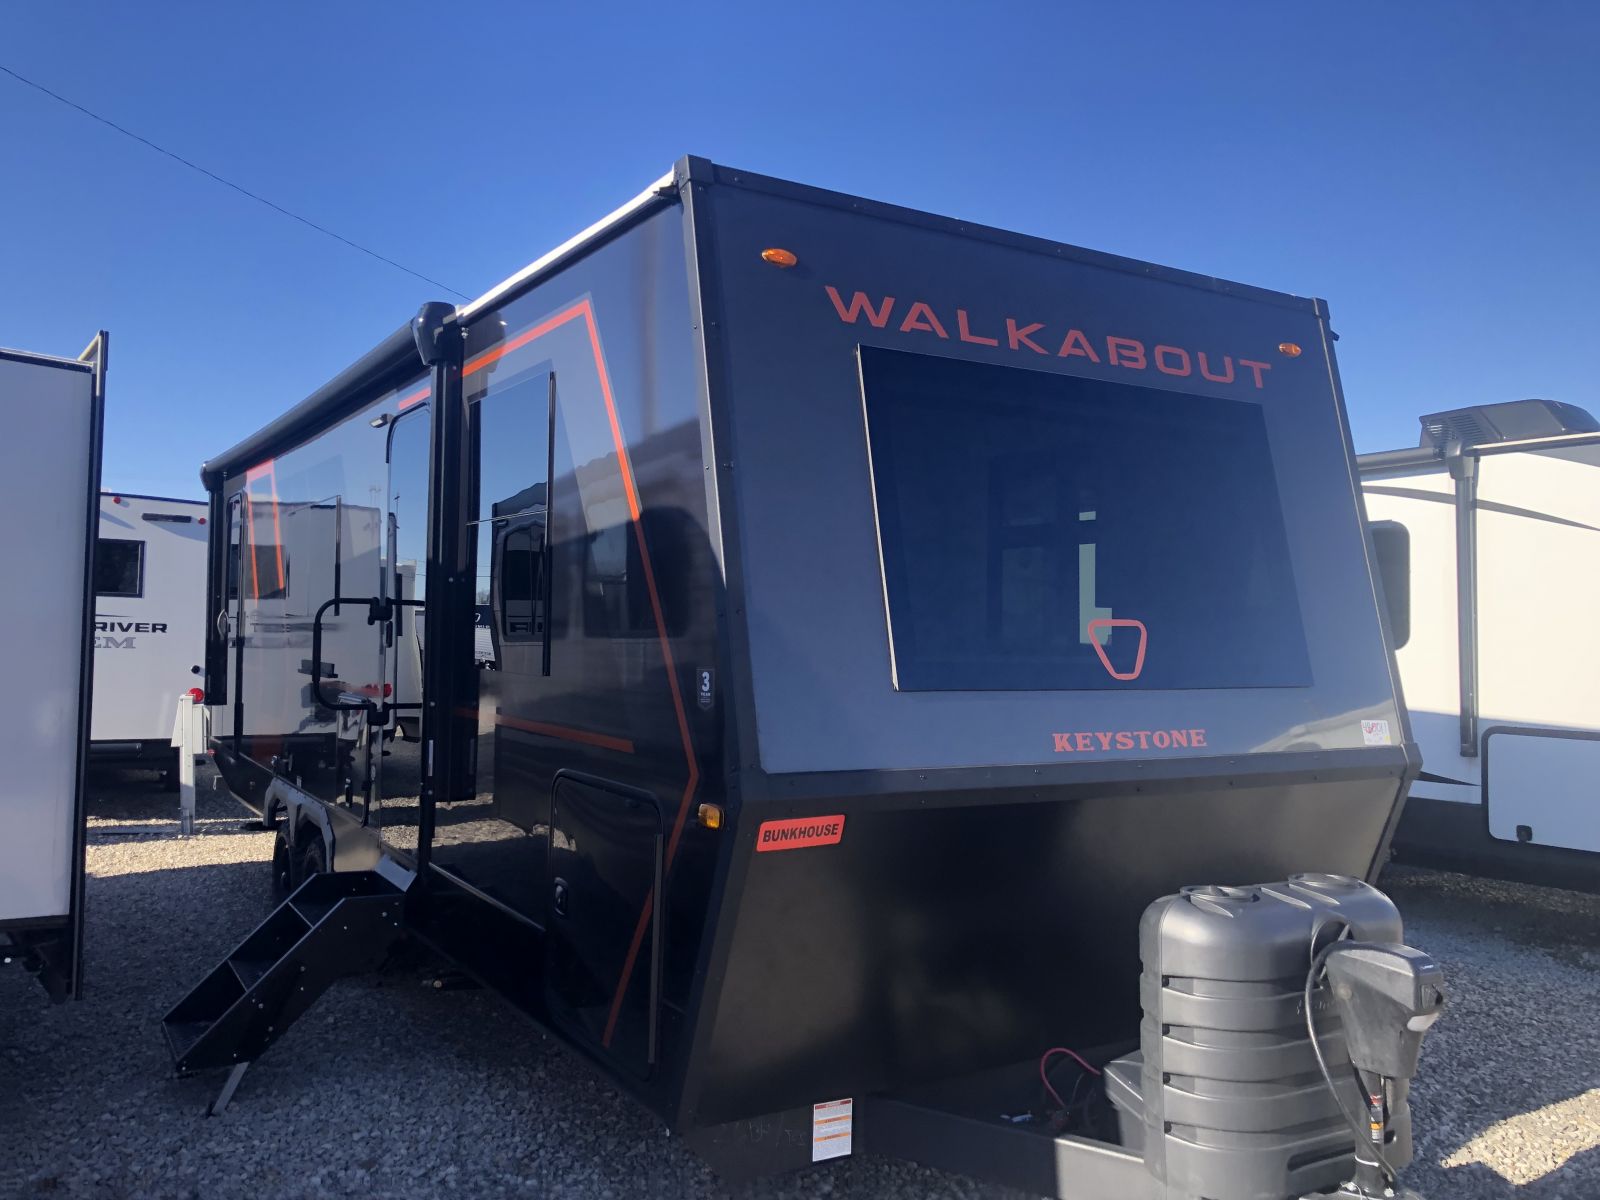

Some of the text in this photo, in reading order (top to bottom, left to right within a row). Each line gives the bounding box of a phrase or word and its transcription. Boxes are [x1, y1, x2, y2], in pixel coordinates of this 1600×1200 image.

[825, 286, 1271, 388] WALKABOUT
[95, 621, 168, 633] RIVER
[702, 671, 710, 692] 3
[1052, 729, 1208, 752] KEYSTONE
[762, 823, 840, 843] BUNKHOUSE
